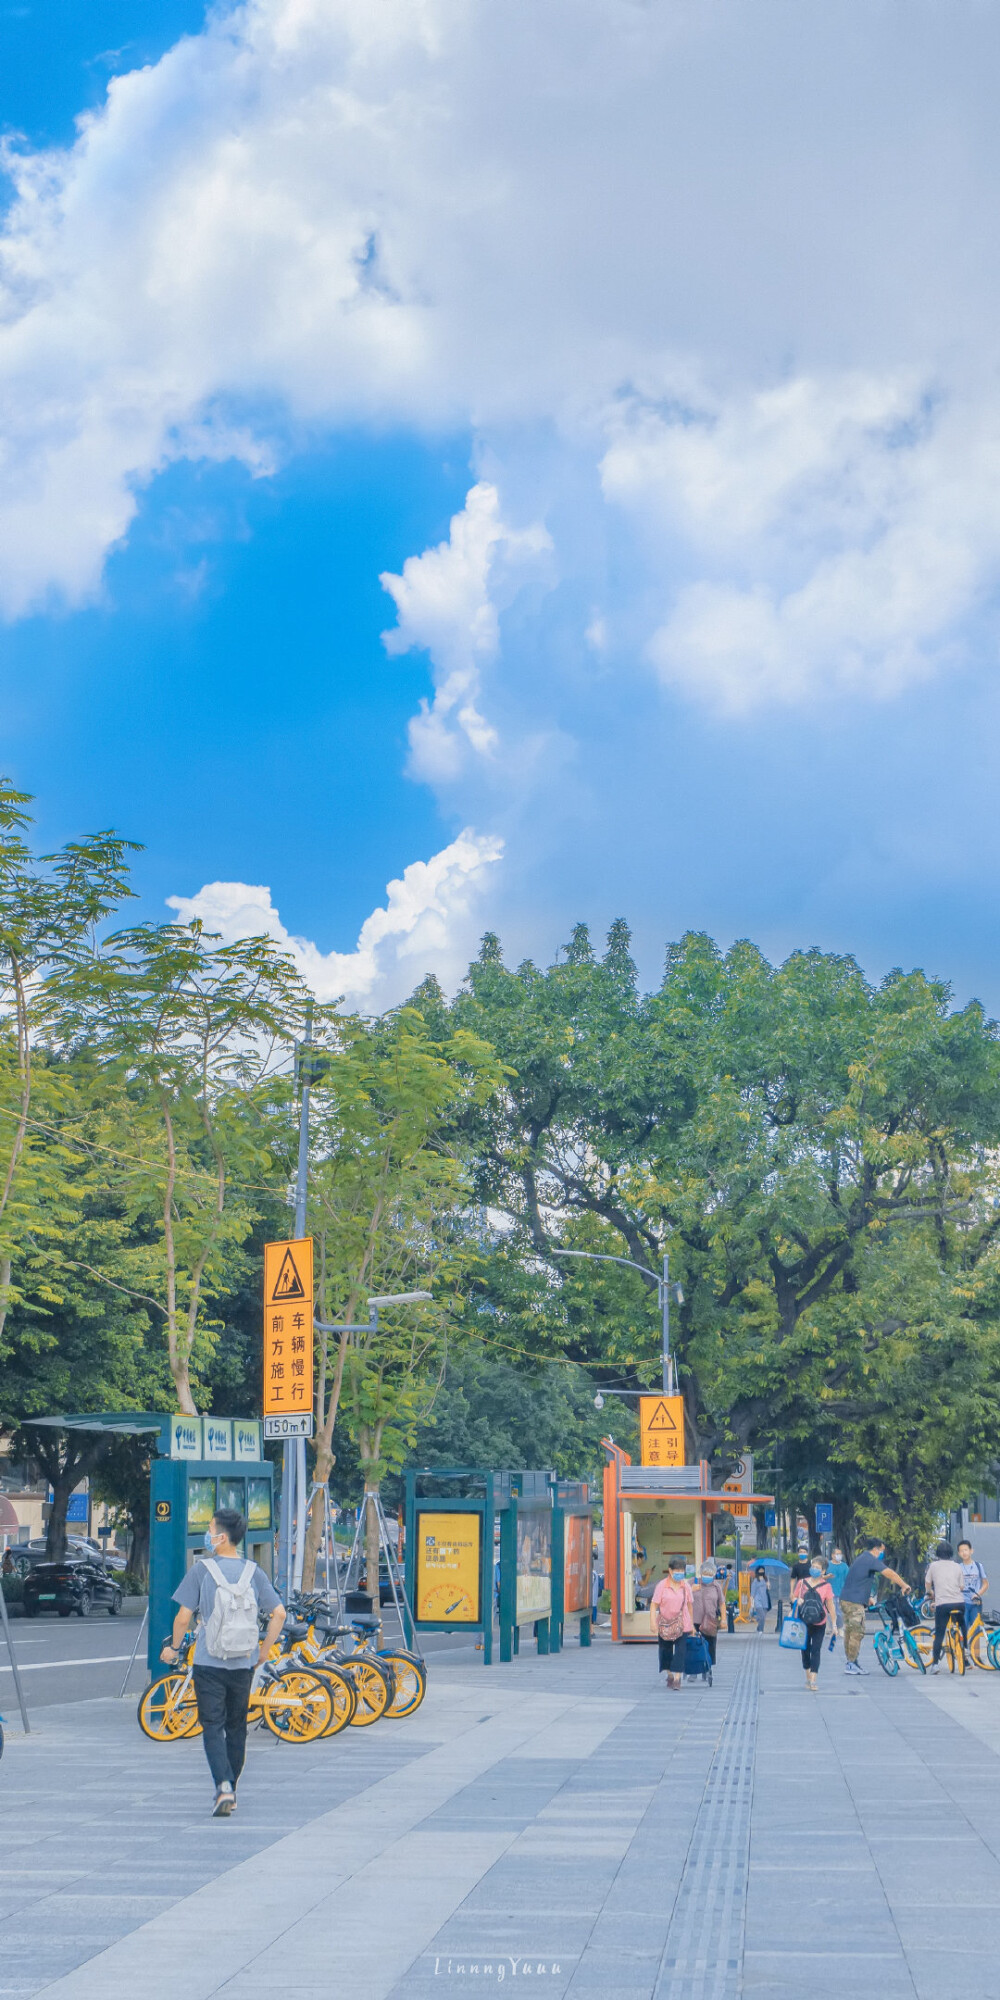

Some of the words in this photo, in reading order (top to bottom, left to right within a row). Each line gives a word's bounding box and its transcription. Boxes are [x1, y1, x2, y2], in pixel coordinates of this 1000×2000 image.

[270, 1316, 285, 1402] 前方施工
[291, 1312, 305, 1400] 车辆慢行
[268, 1419, 299, 1434] 150m
[648, 1438, 660, 1466] 注意
[666, 1437, 679, 1466] 引导
[821, 1512, 827, 1521] P
